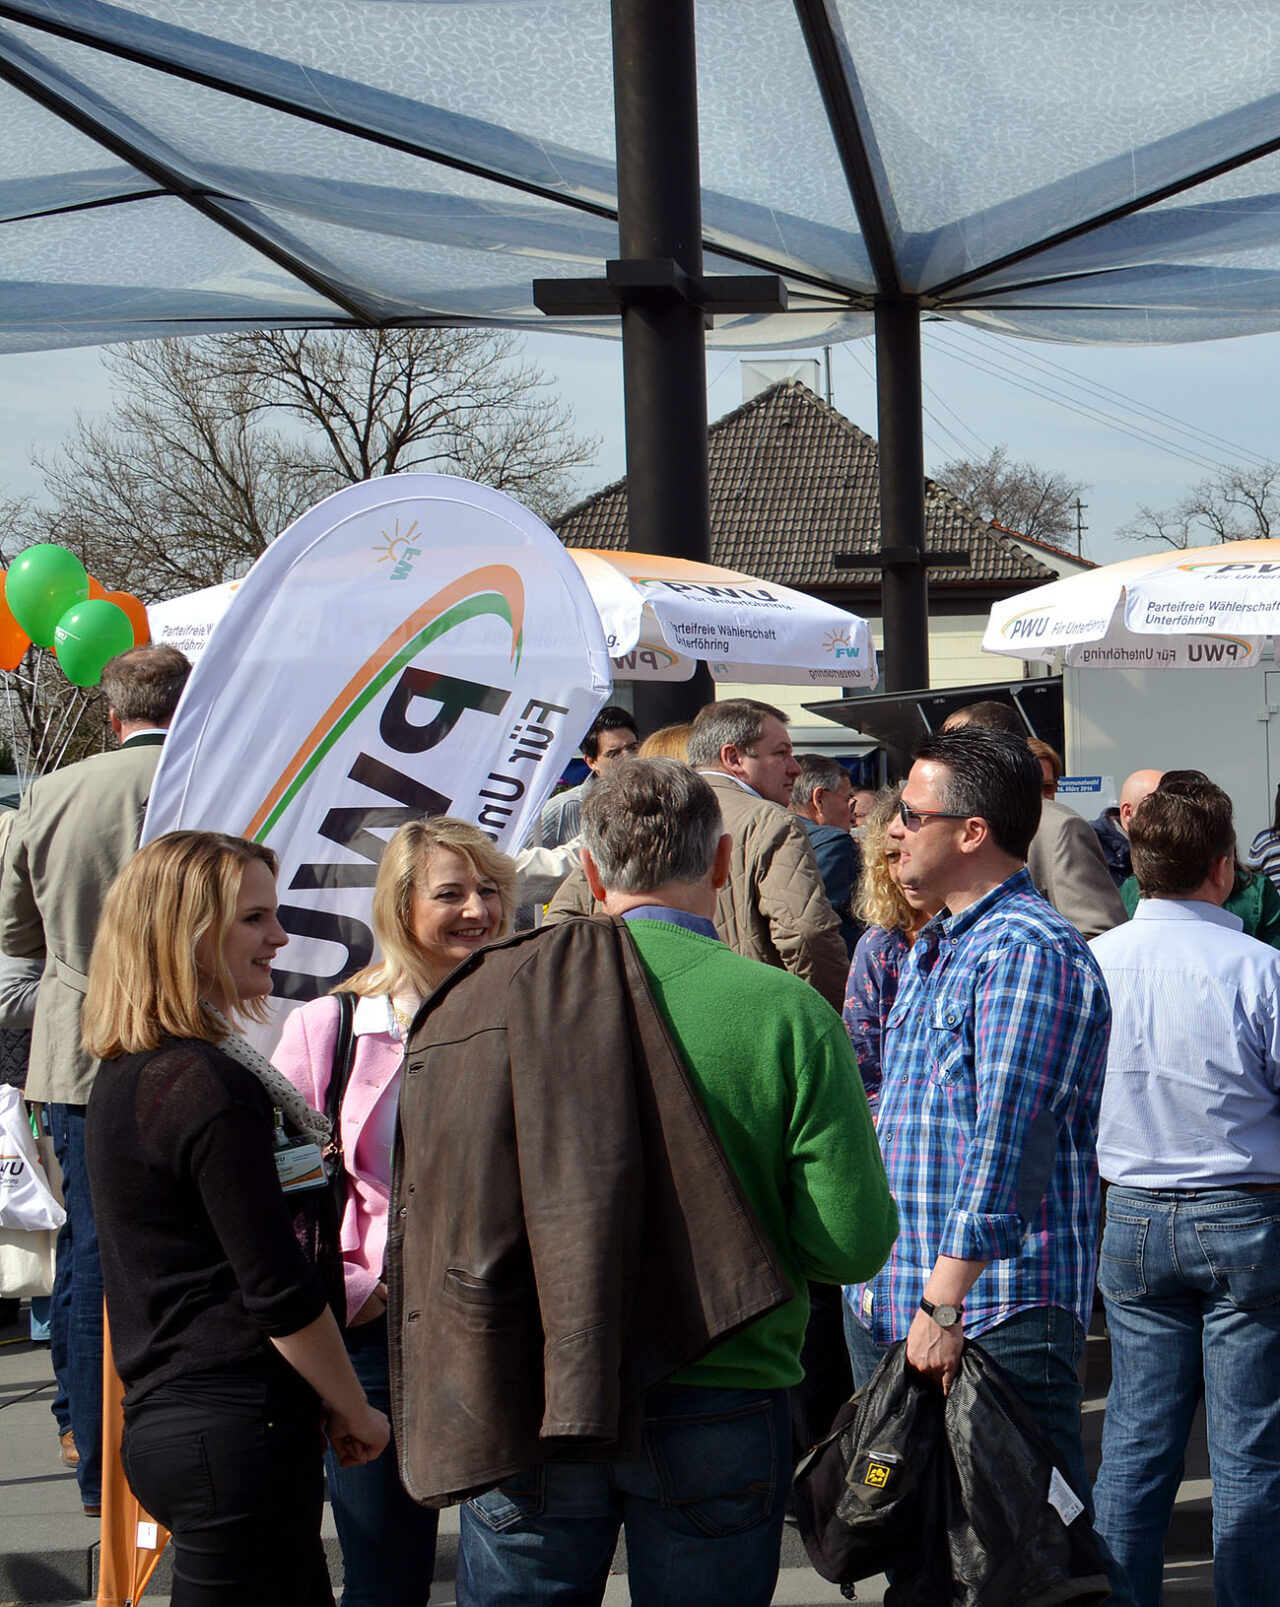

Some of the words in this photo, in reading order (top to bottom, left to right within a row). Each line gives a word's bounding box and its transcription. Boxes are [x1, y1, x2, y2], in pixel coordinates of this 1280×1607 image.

[662, 581, 778, 601] PWU
[1148, 601, 1205, 615] Parteifreie
[1208, 600, 1280, 613] Wählerschaft
[1010, 617, 1050, 639] PWU
[1145, 614, 1216, 627] Unterföhring
[717, 624, 777, 640] Wählerschaft
[835, 647, 860, 658] FW
